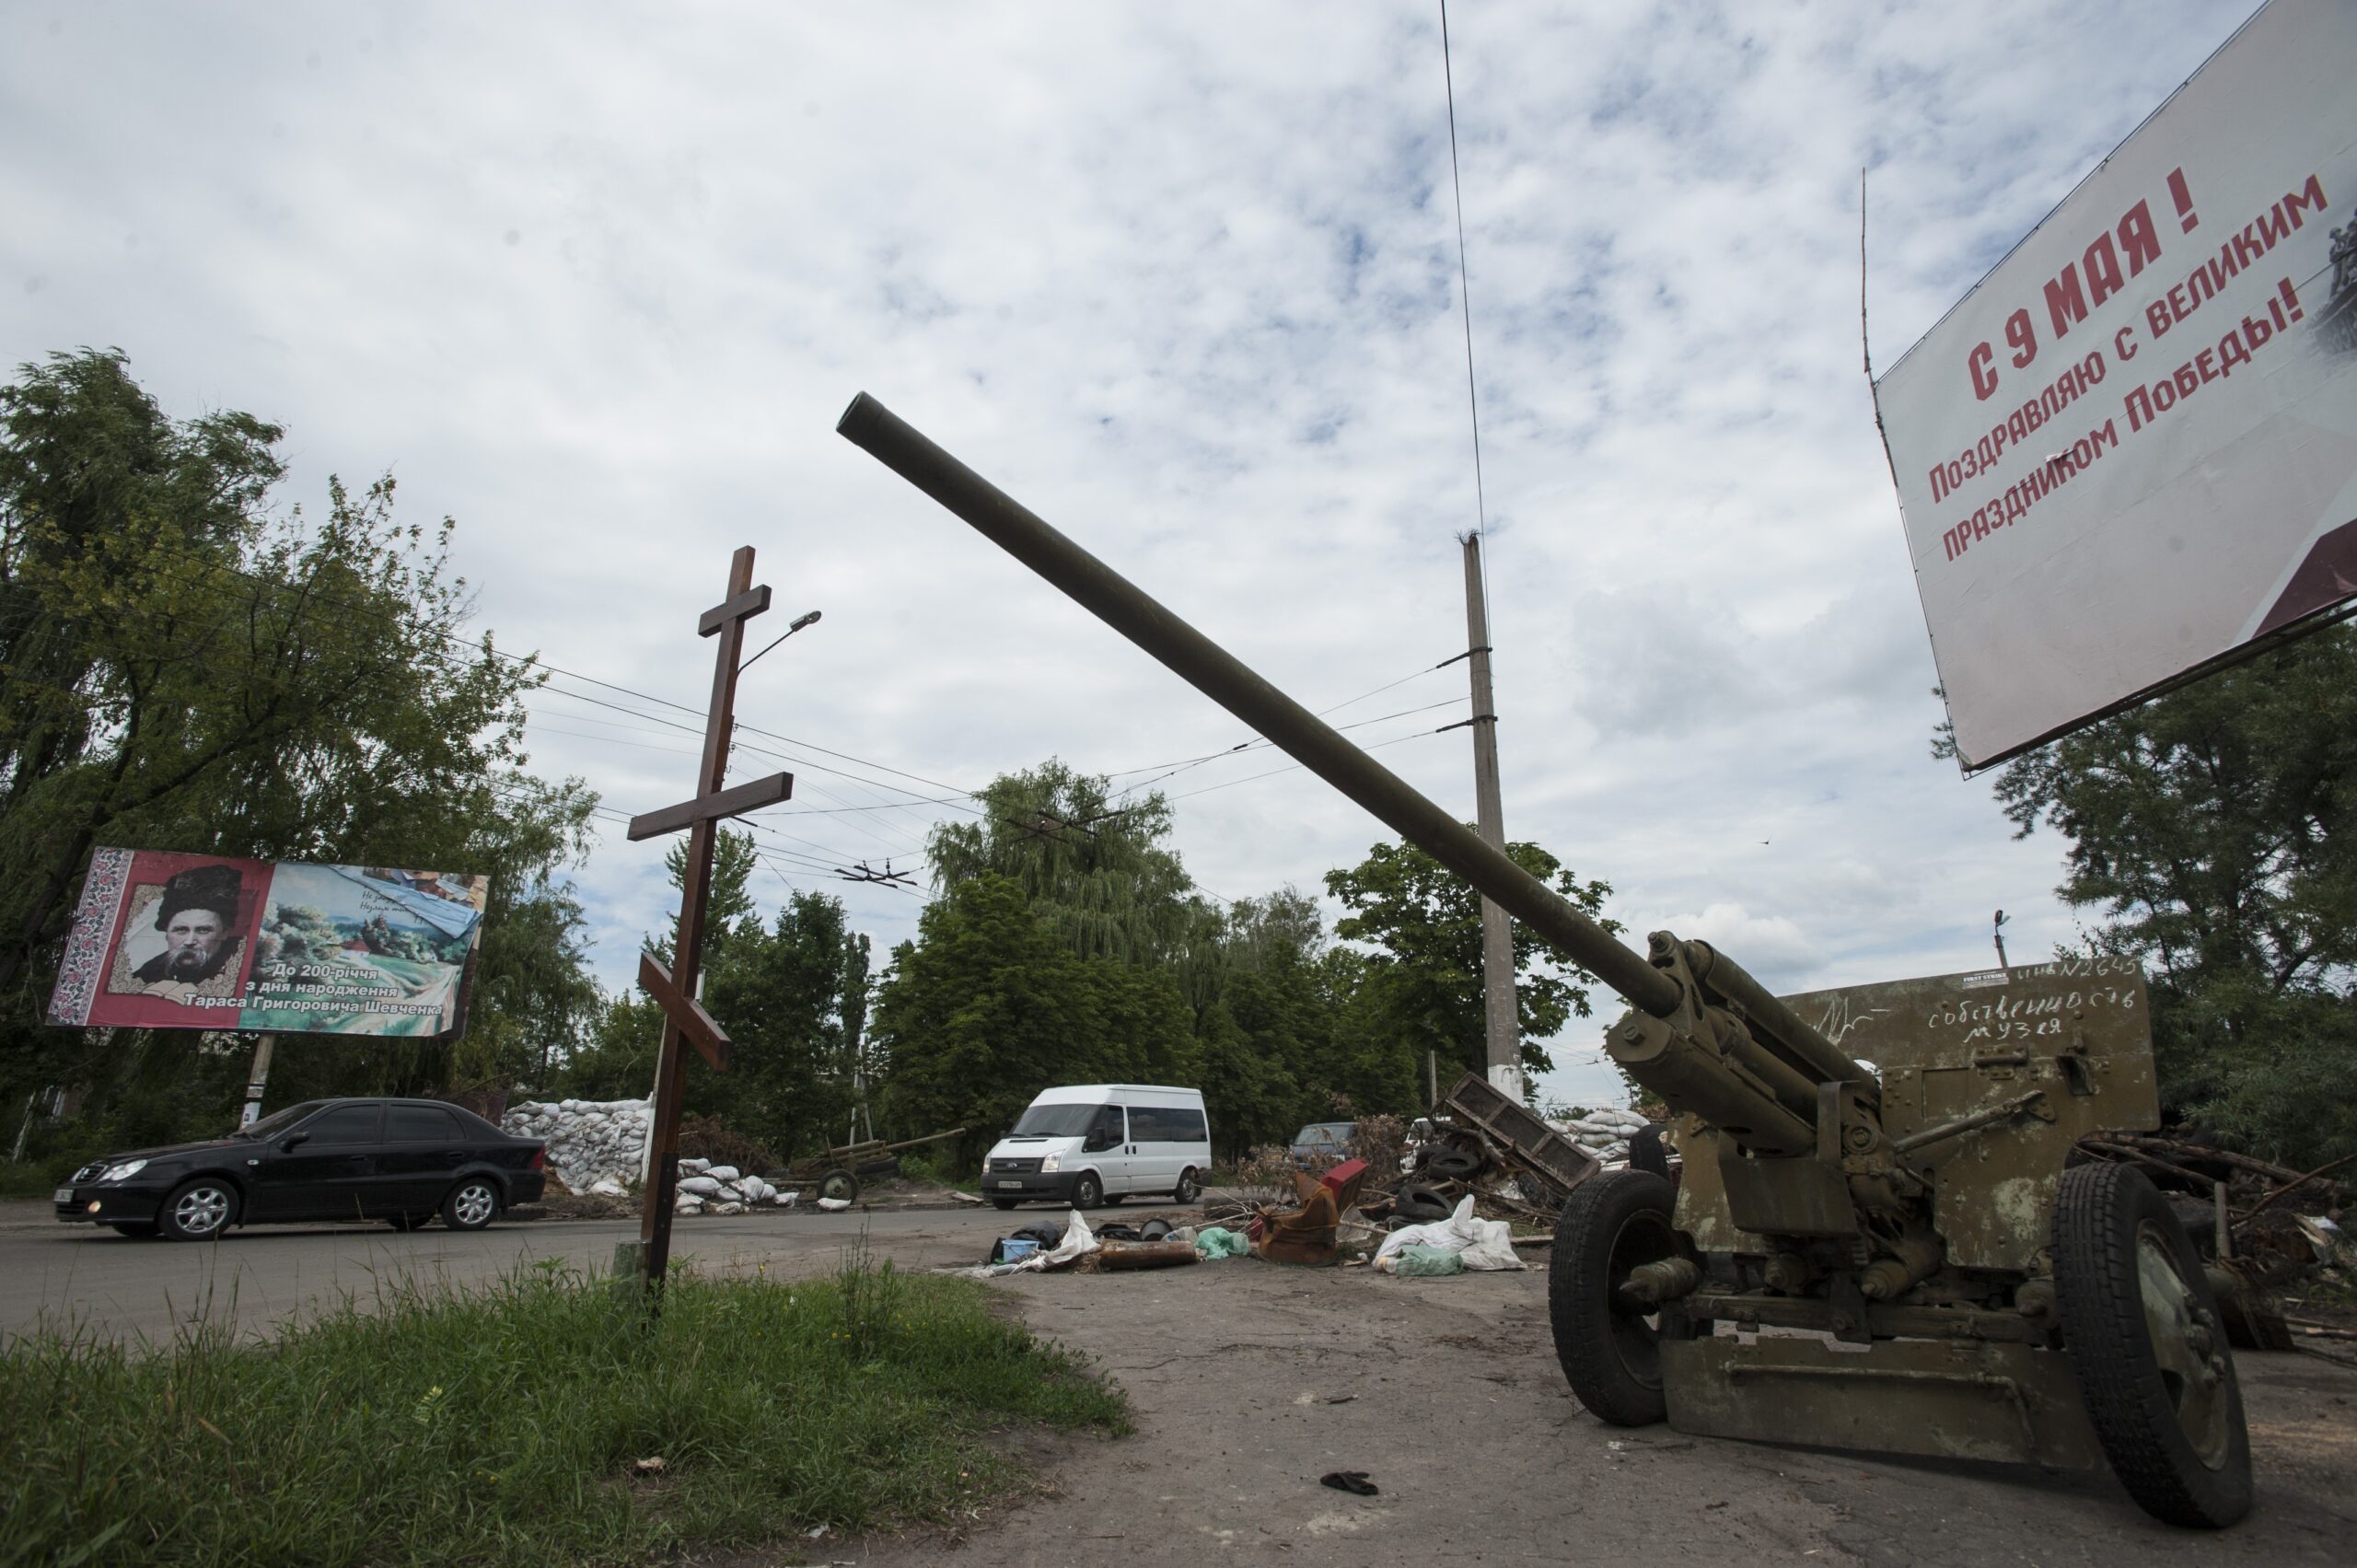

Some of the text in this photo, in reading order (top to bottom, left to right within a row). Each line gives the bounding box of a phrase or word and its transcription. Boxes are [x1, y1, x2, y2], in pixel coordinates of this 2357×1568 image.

[1929, 351, 2107, 504] ПОЗДРАВЛЯЮ
[2145, 173, 2328, 340] ВЕЛИКИМ
[1968, 342, 1998, 401] С
[2005, 308, 2038, 368] 9
[1942, 276, 2304, 562] ПРАЗДНИКОМ ПОБЕДЫ!
[245, 981, 399, 998] з дня народження
[273, 964, 379, 981] До 200-річчя
[185, 993, 247, 1009] Тараса
[251, 995, 359, 1014] Григоровича
